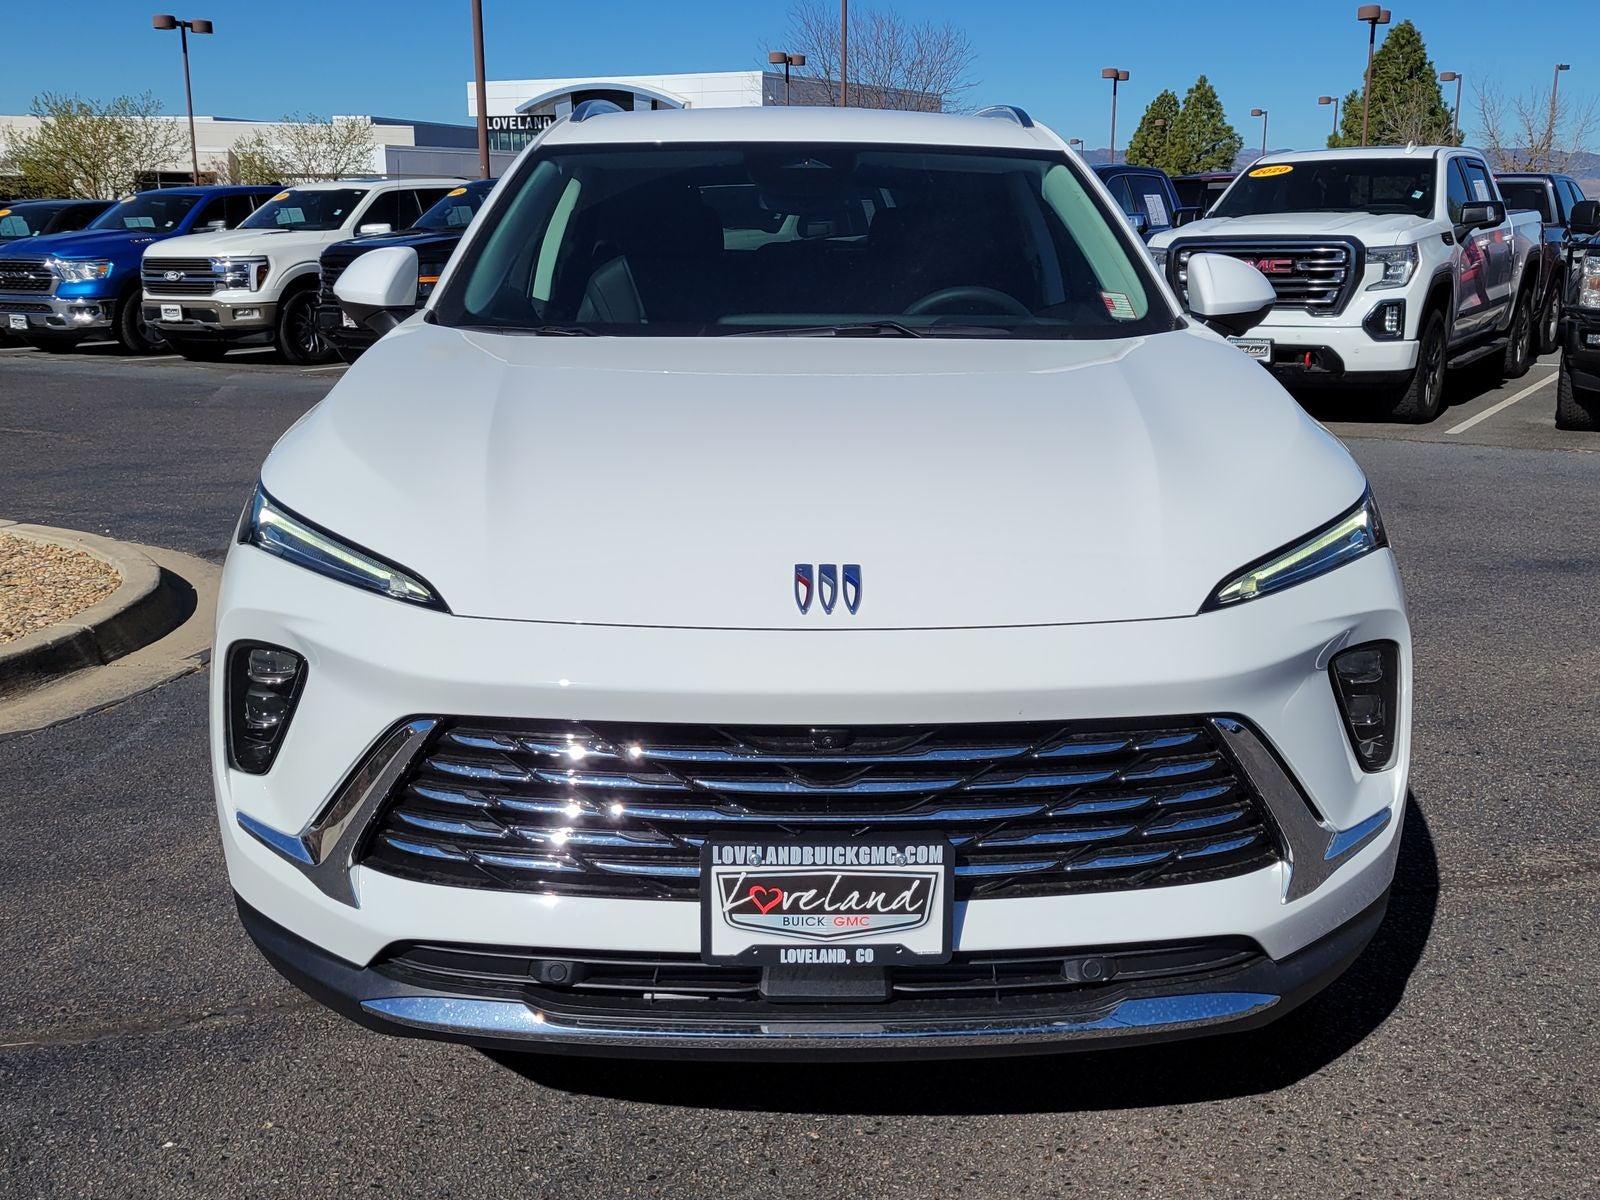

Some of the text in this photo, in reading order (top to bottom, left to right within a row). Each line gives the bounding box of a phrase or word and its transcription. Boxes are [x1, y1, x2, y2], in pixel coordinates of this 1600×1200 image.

[486, 116, 552, 130] LOVELAND
[1243, 259, 1292, 273] MC
[712, 845, 943, 865] LOVELANDBUICKGMCCOM
[782, 916, 871, 927] BUICK GMC
[780, 948, 874, 965] LOVELAND, CO
